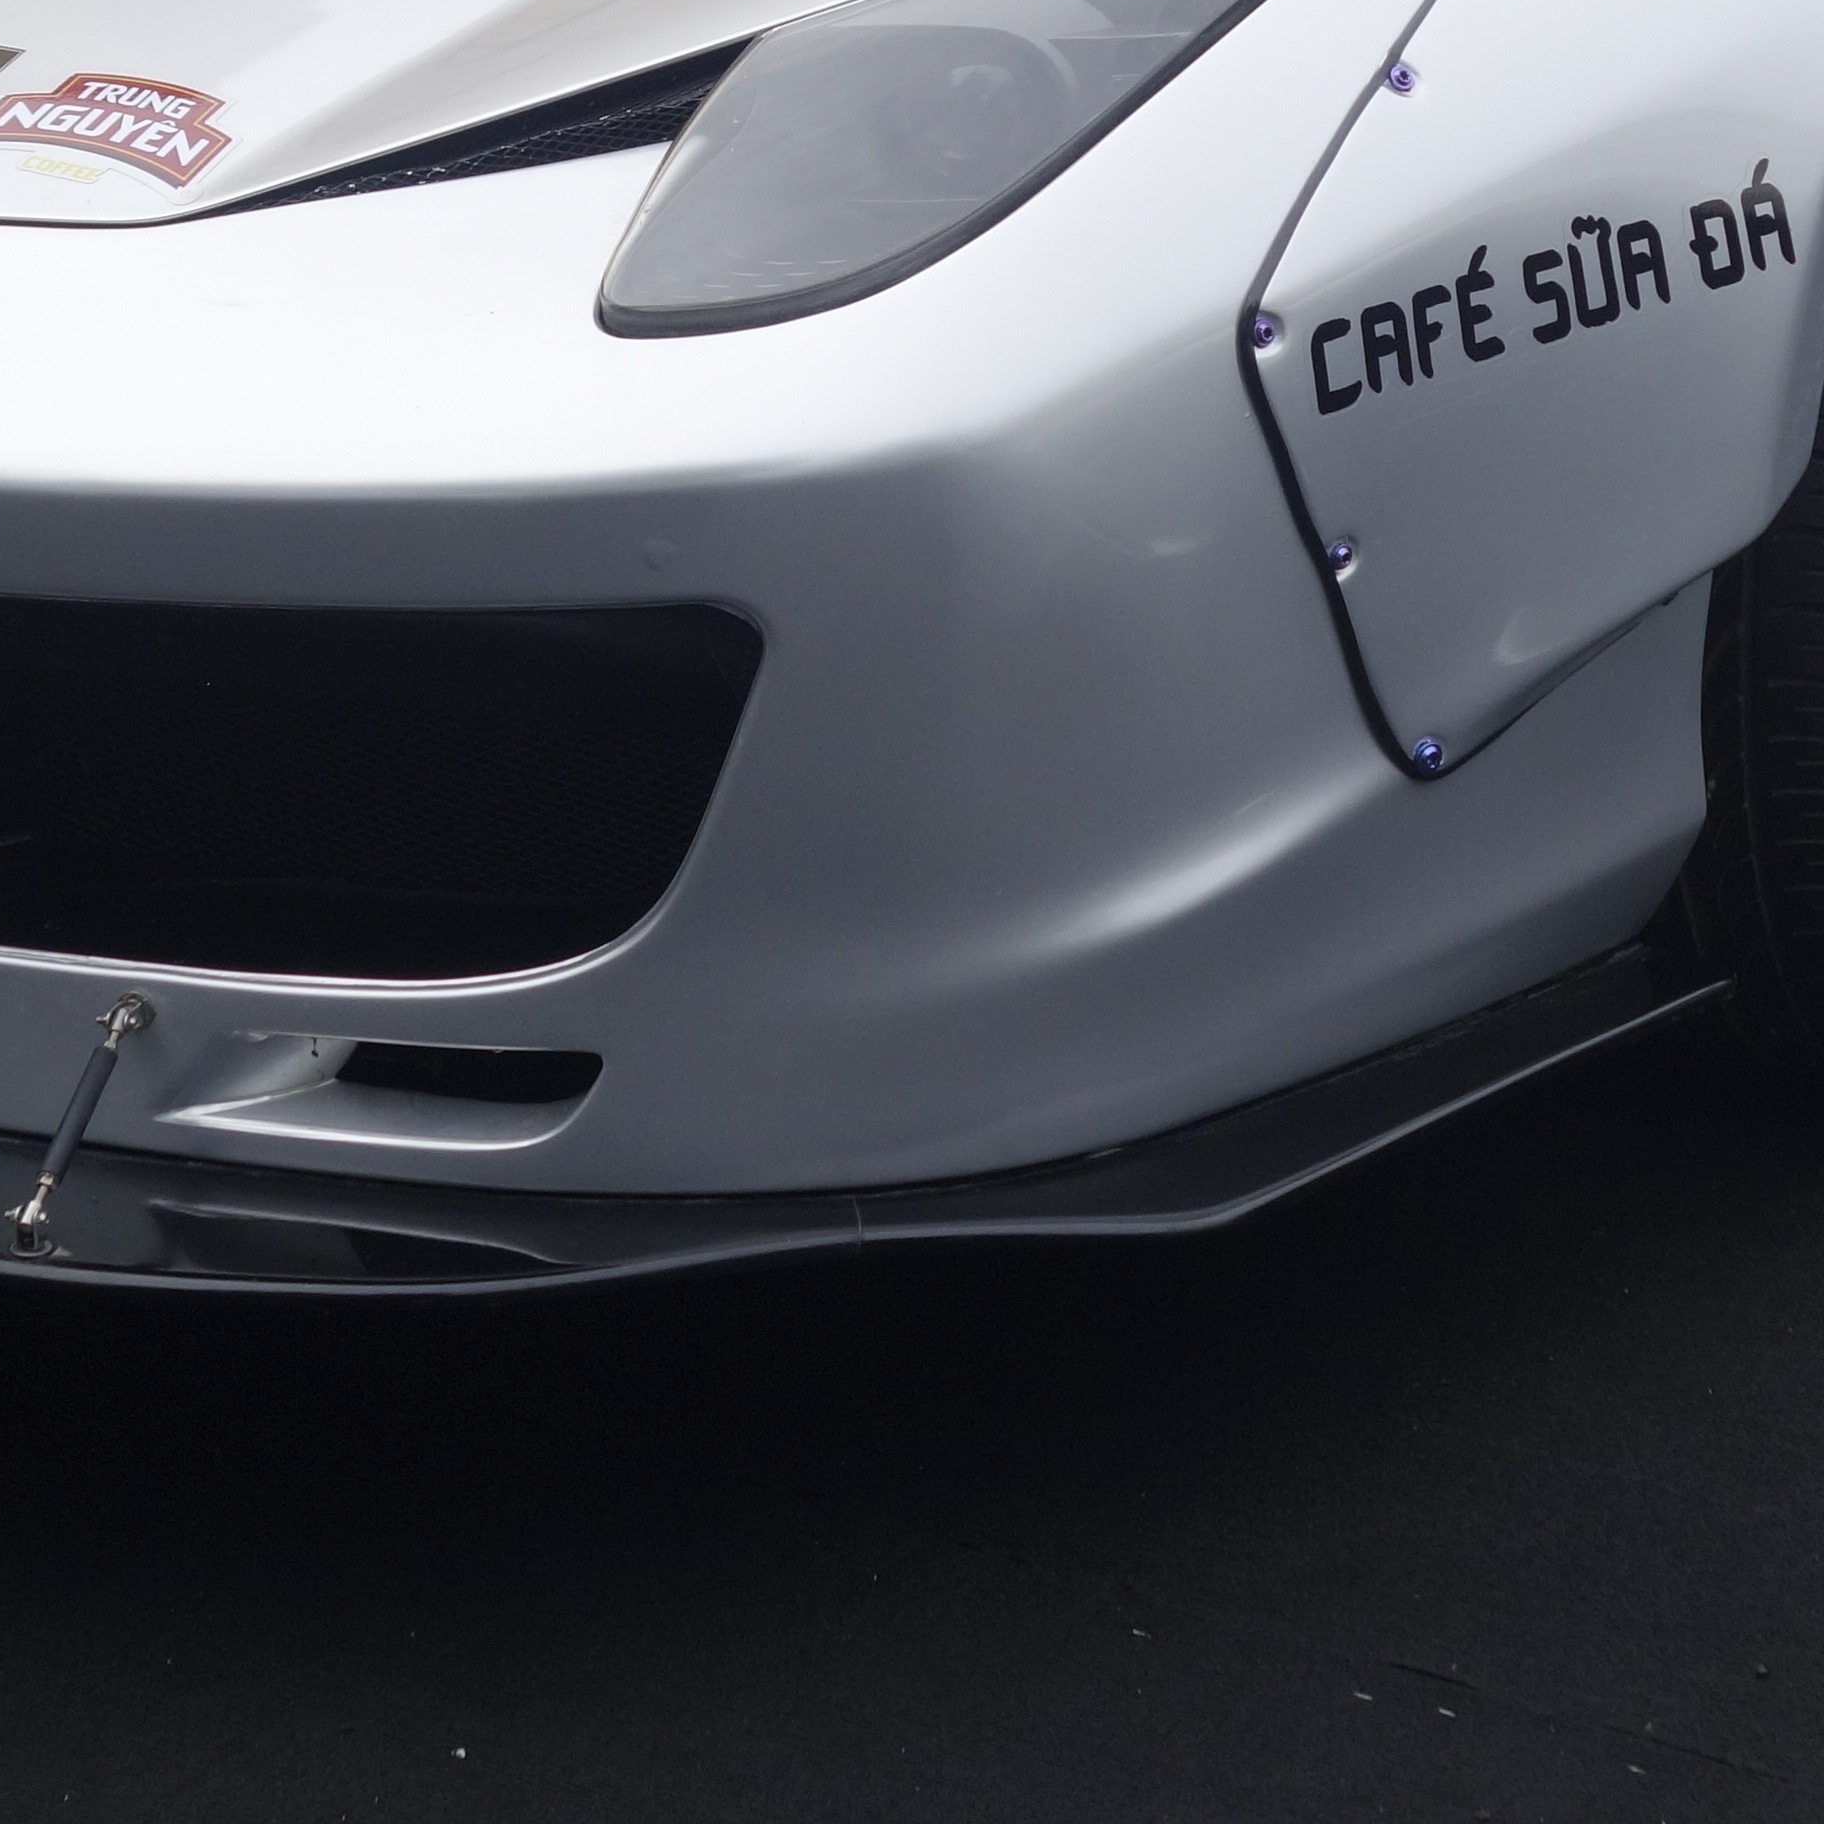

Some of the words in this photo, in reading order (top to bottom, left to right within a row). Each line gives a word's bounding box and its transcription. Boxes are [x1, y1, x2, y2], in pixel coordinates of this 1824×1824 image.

[77, 80, 197, 121] TRUNG
[22, 153, 102, 182] COFFEE
[1310, 244, 1507, 417] CAFÉ
[1521, 213, 1672, 346] SỮA
[1689, 157, 1797, 291] ĐÁ
